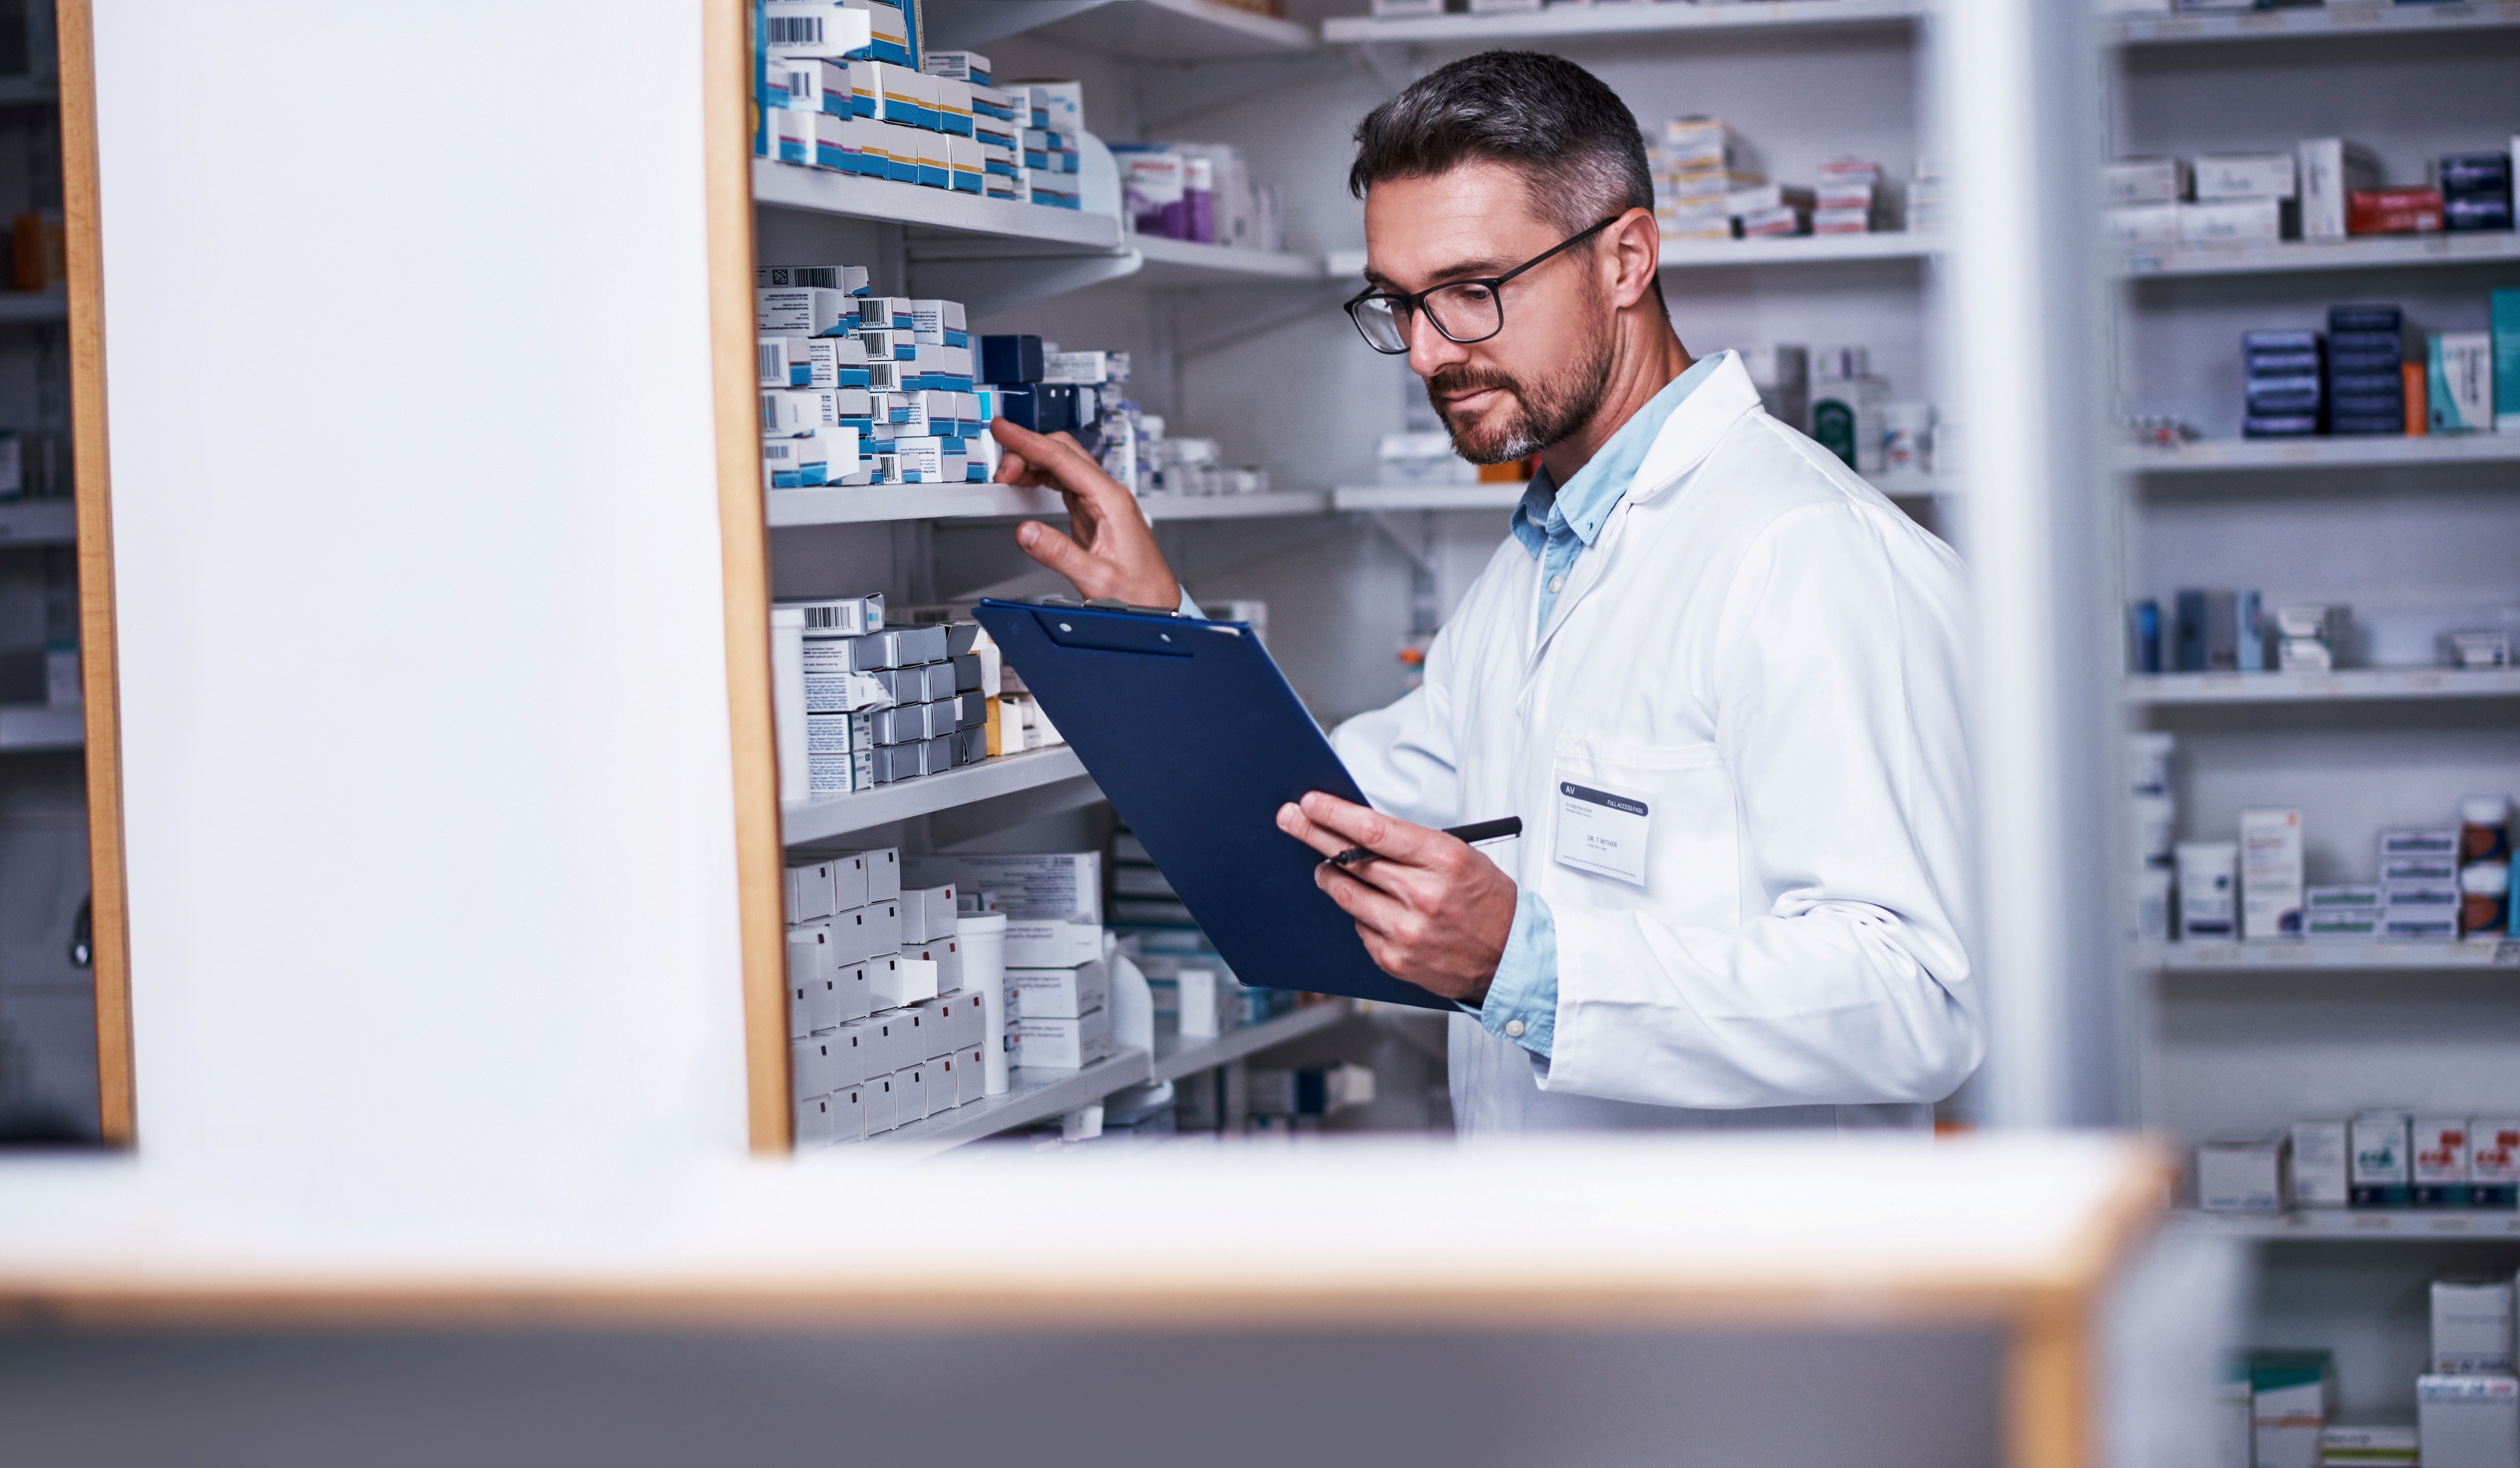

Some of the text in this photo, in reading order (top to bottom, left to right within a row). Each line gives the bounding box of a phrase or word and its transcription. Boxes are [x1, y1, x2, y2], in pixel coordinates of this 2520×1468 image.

[1566, 786, 1575, 794] AV
[1617, 803, 1632, 811] ACCESS
[1600, 838, 1617, 848] WITHER
